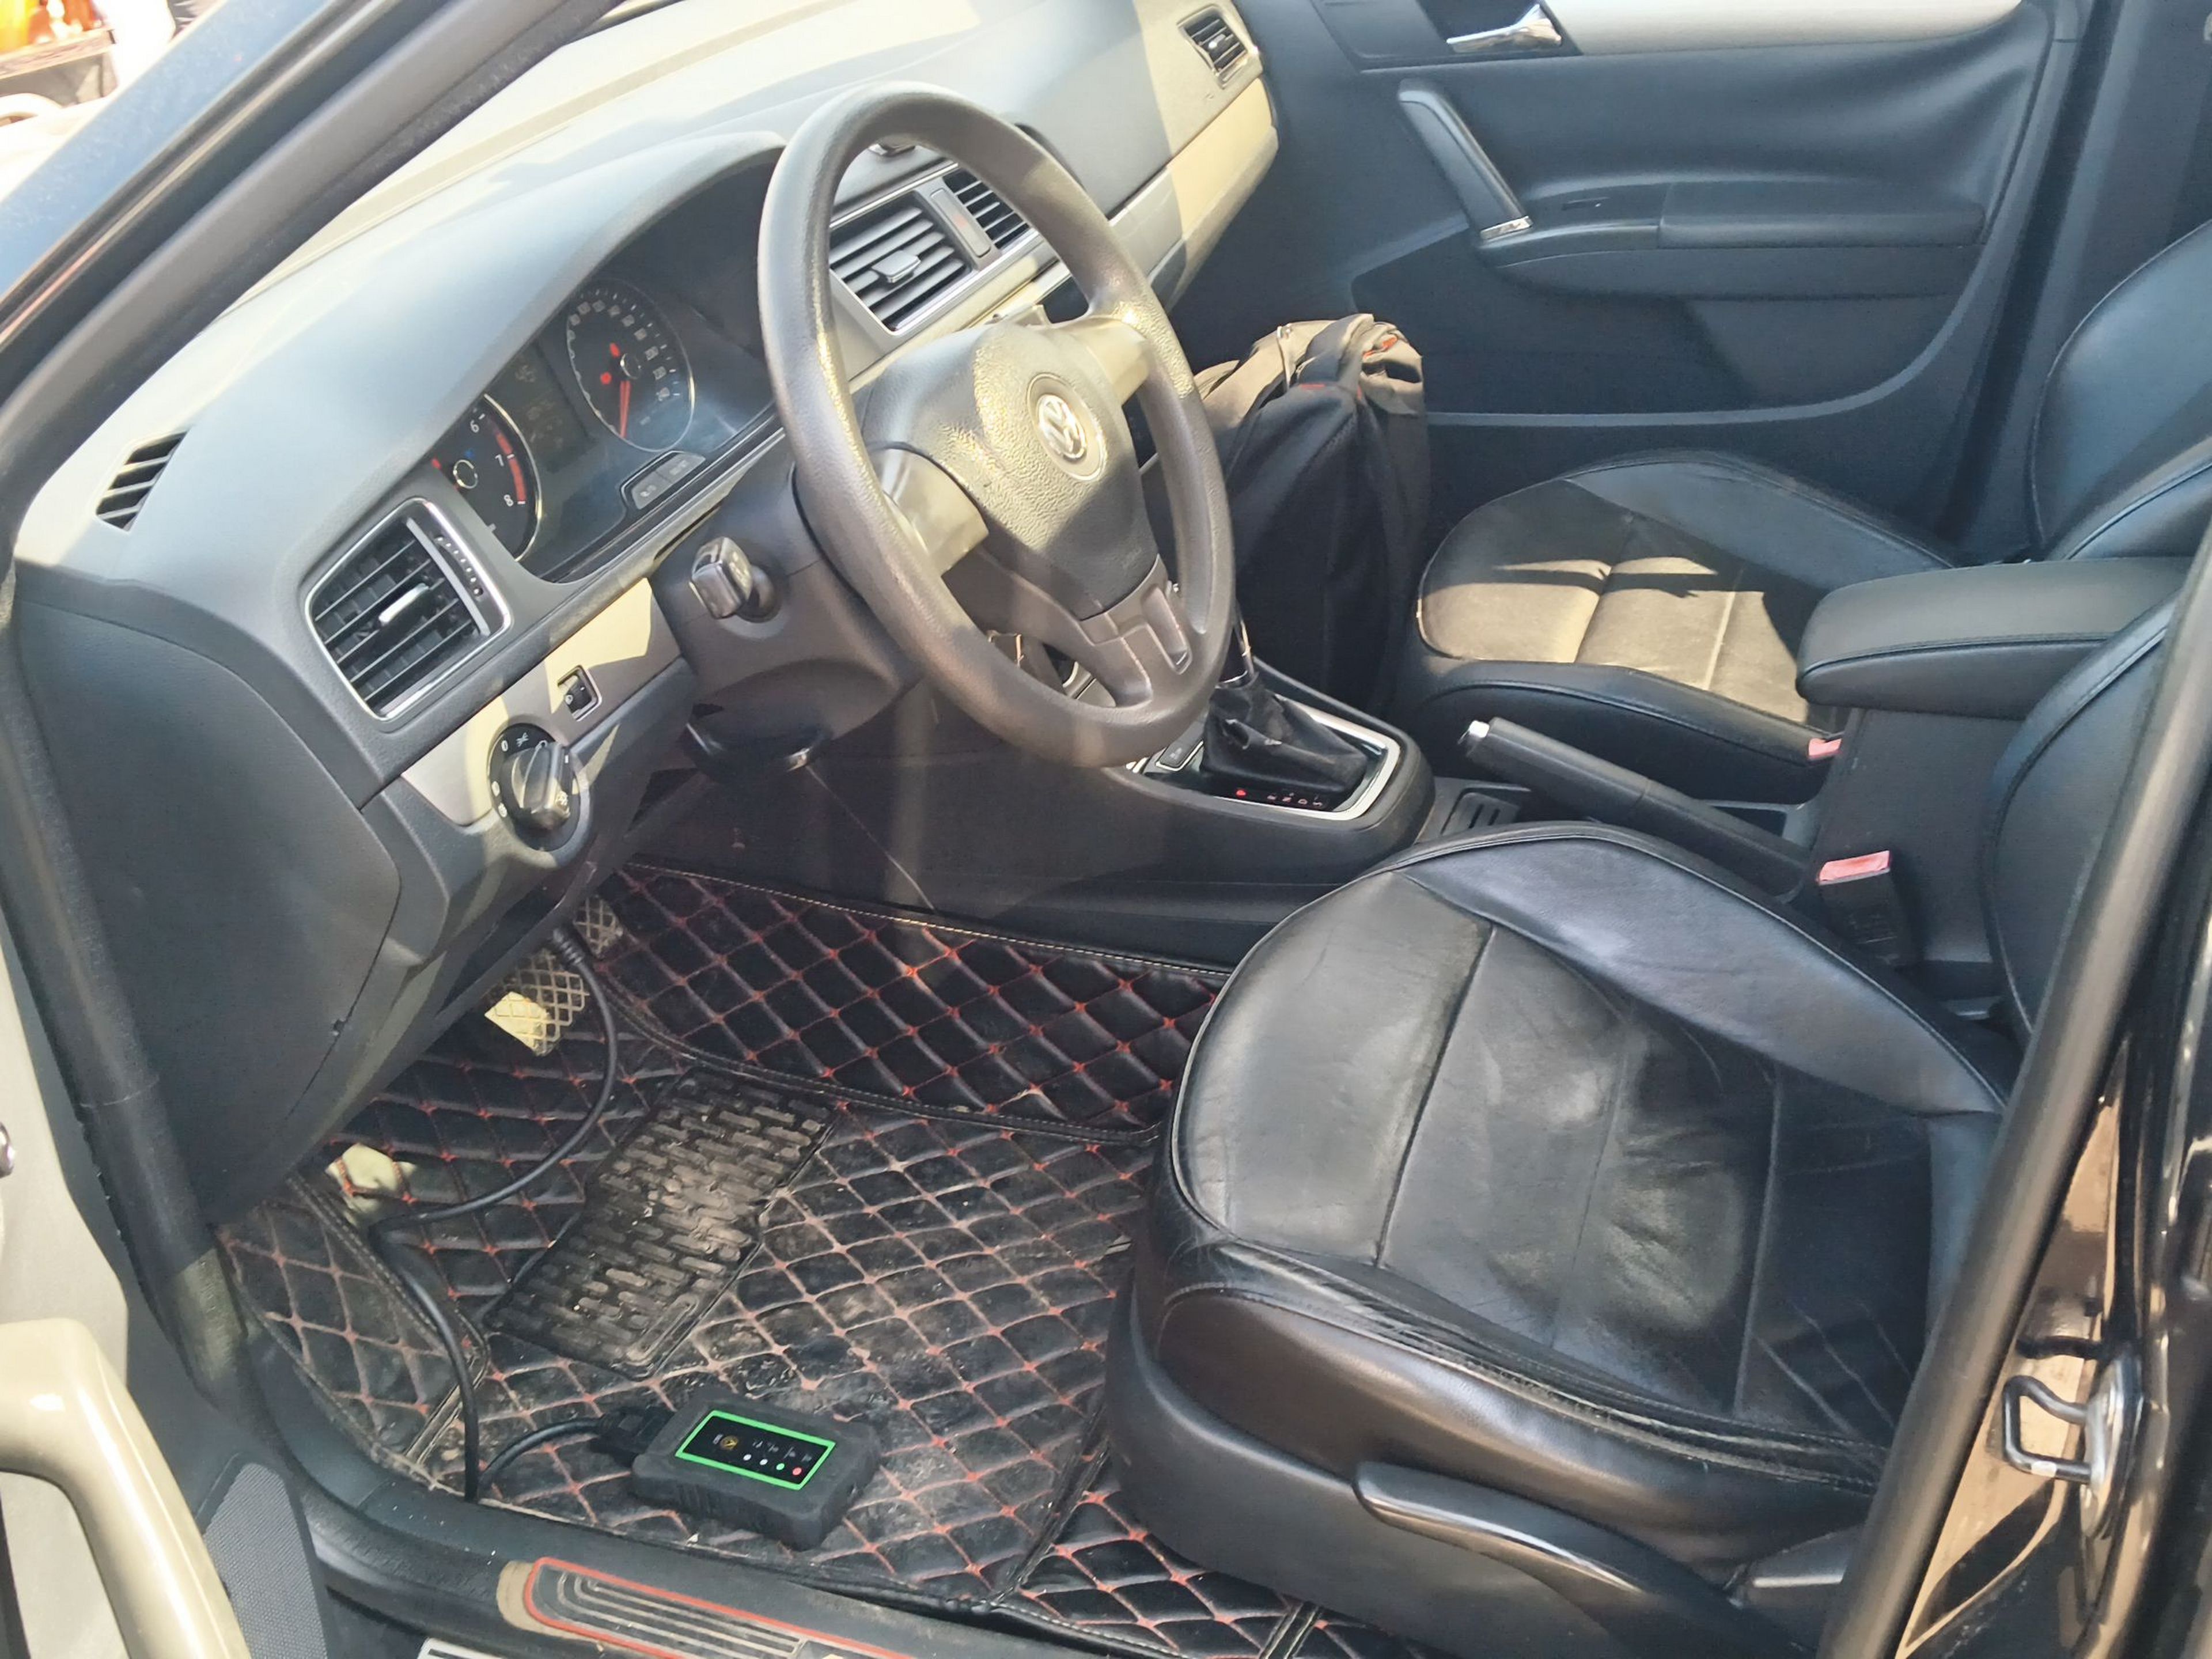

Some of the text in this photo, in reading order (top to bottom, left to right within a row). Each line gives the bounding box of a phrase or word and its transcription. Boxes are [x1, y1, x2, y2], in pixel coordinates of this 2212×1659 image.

[469, 419, 480, 433] 6
[494, 453, 505, 467] 7
[503, 494, 514, 507] 8
